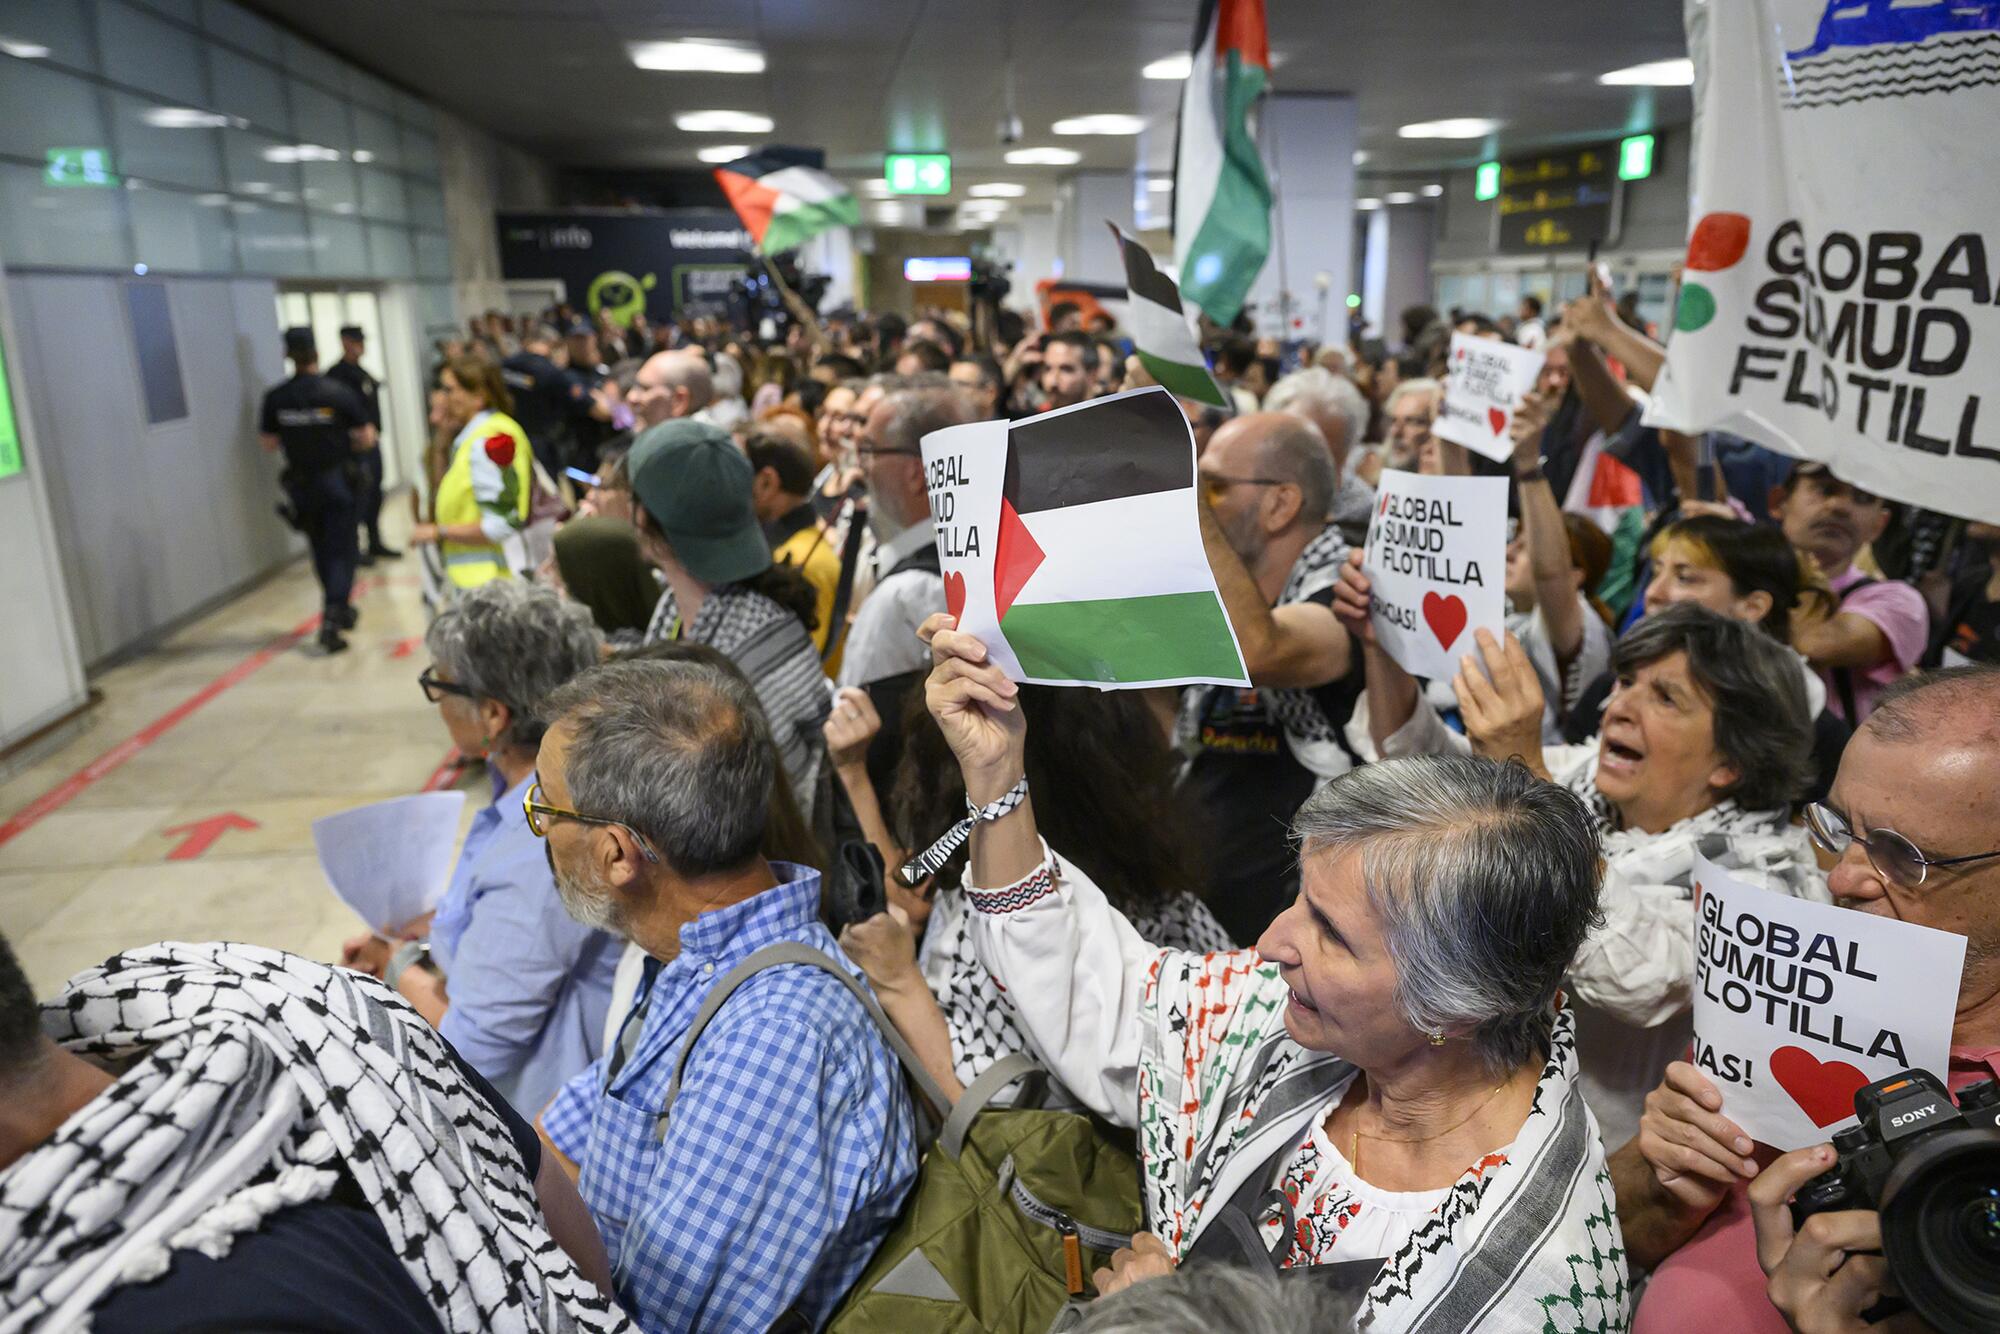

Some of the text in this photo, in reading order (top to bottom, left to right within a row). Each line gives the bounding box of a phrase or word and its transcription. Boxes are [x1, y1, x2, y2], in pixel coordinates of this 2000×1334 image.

[1766, 219, 2000, 307] GOBA
[1383, 519, 1444, 553] SUMUD
[1388, 494, 1463, 526] GLOBAL
[1382, 546, 1484, 587] FLOTILLA
[1699, 924, 1834, 1005] SUMUD
[1702, 891, 1878, 982] GLOBAL
[1696, 957, 1910, 1070] FLOTILLA
[1693, 1030, 1753, 1088] IAS!
[1891, 1103, 1937, 1127] SONY
